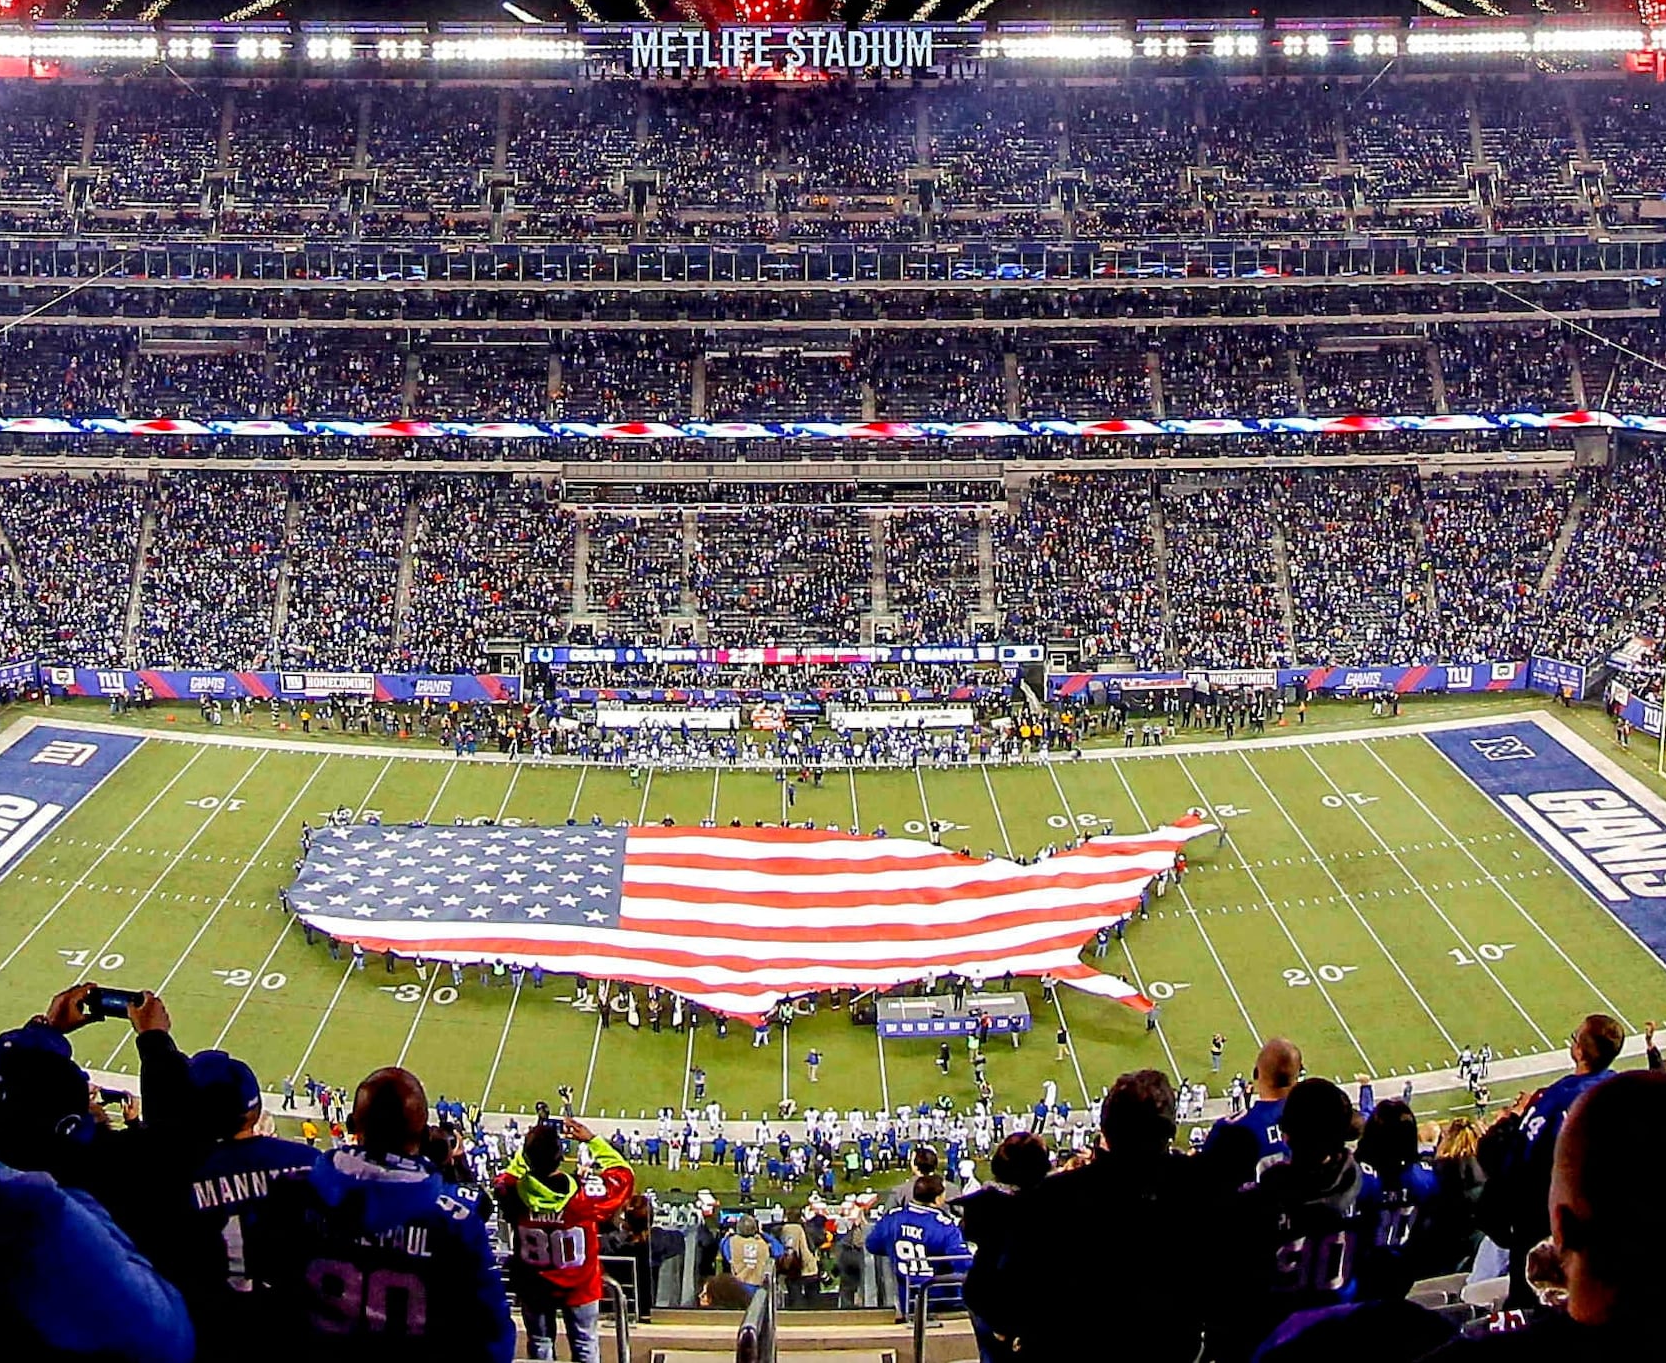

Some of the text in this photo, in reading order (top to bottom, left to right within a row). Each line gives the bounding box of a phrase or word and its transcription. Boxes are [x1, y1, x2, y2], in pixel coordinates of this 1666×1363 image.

[632, 29, 934, 68] METLIFE STADIUM
[306, 676, 373, 690] HOMECOMING
[1209, 672, 1274, 686] HOMECOMING
[66, 949, 125, 971] 10
[1447, 942, 1506, 967] 10
[222, 969, 287, 990] 20
[1281, 964, 1346, 988] 20
[393, 984, 460, 1005] 30
[517, 1226, 586, 1269] 80
[895, 1240, 934, 1277] 91
